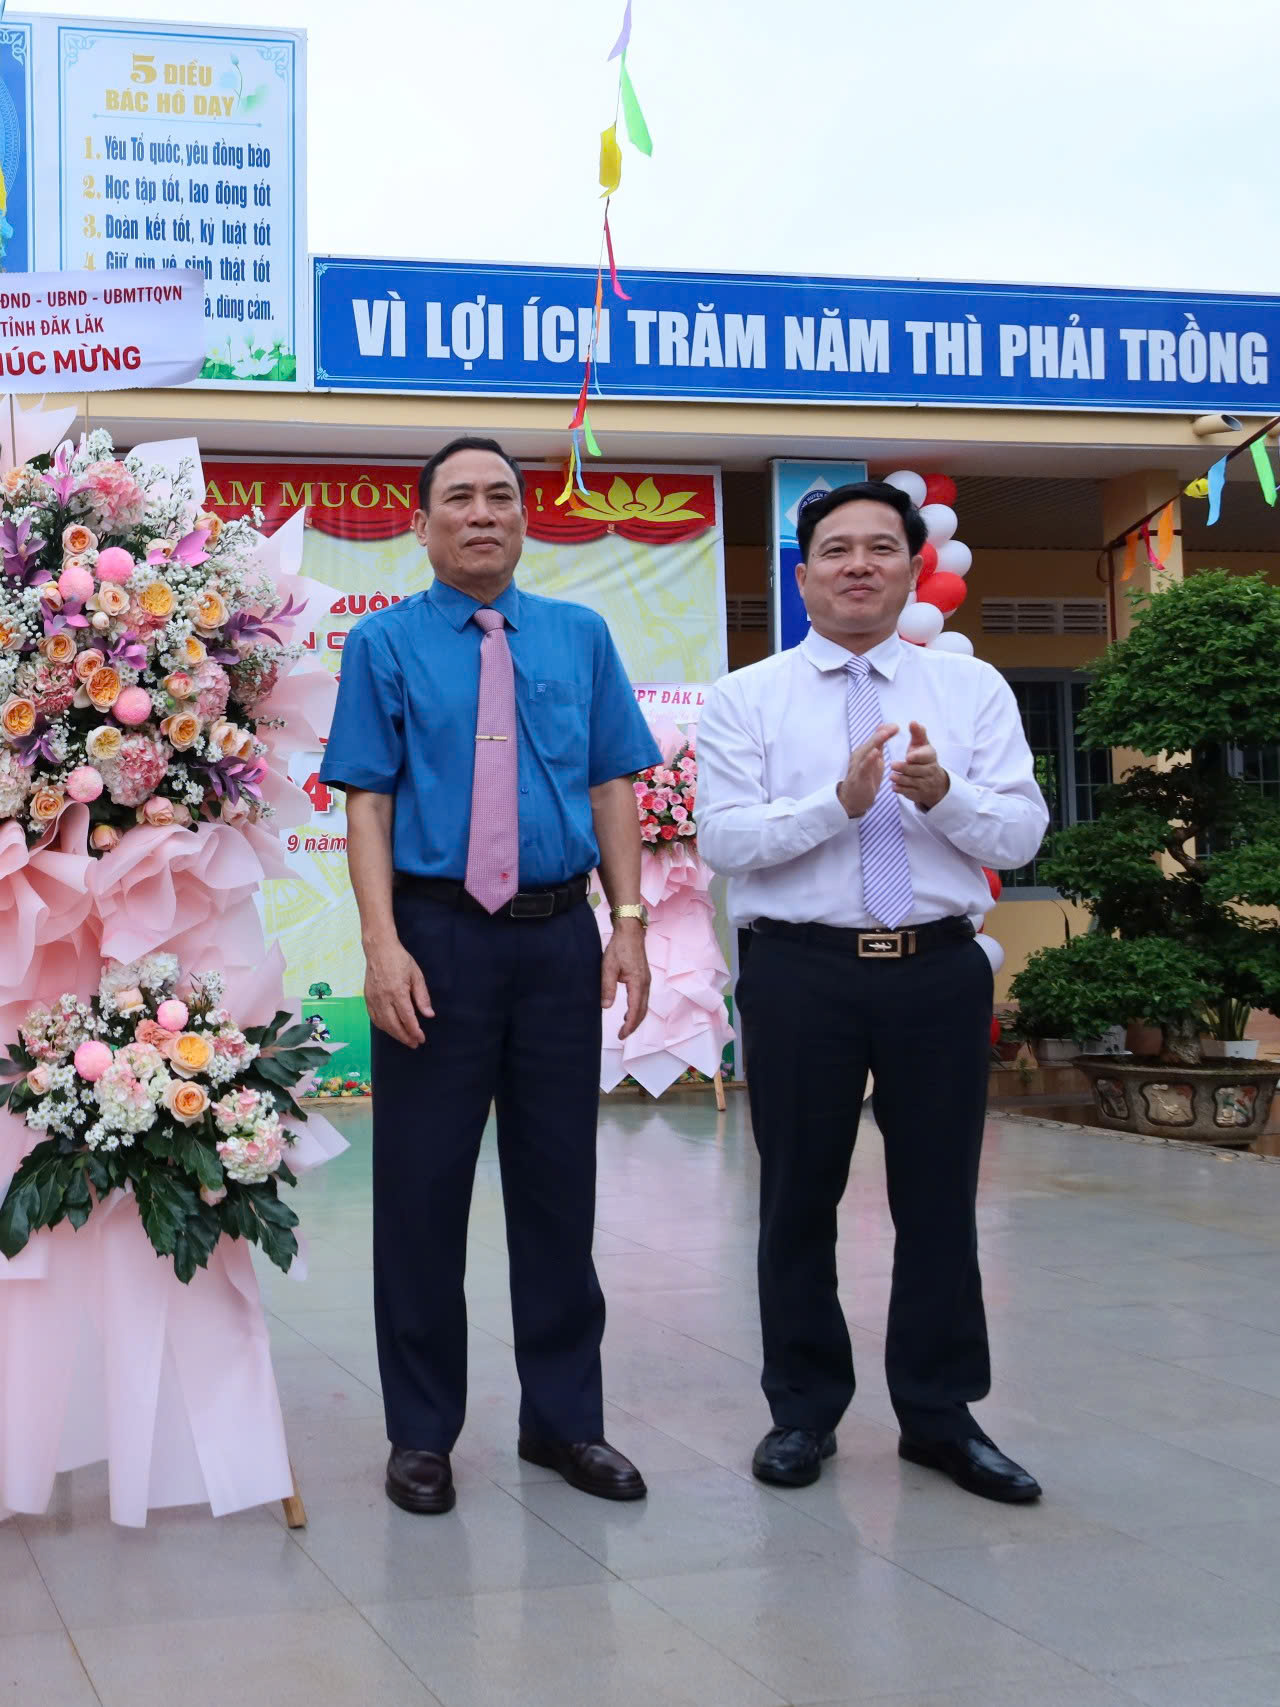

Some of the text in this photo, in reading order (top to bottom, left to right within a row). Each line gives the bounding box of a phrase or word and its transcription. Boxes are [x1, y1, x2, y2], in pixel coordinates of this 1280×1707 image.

[130, 53, 213, 87] 5 ĐIỀU
[105, 88, 234, 120] BÁC HỒ DẠY
[105, 132, 270, 169] Yêu Tổ quốc, yêu đồng bào
[105, 174, 271, 209] Học tập tốt, lao động tốt
[83, 213, 271, 249] 3. Đoàn kết tốt, luật tốt
[220, 256, 245, 286] thật
[253, 254, 270, 283] tốt
[47, 290, 88, 307] UBND
[103, 285, 183, 305] UBMTTQVN
[217, 294, 243, 322] dũng
[248, 294, 274, 321] cảm.
[0, 313, 104, 337] TỈNH ĐĂK LĂK
[352, 291, 1269, 385] VÌ LỢI ÍCH TRĂM NĂM THÌ PHẢI TRỒNG
[54, 343, 141, 375] MỪNG
[279, 474, 413, 510] MUÔN
[304, 833, 348, 853] năm
